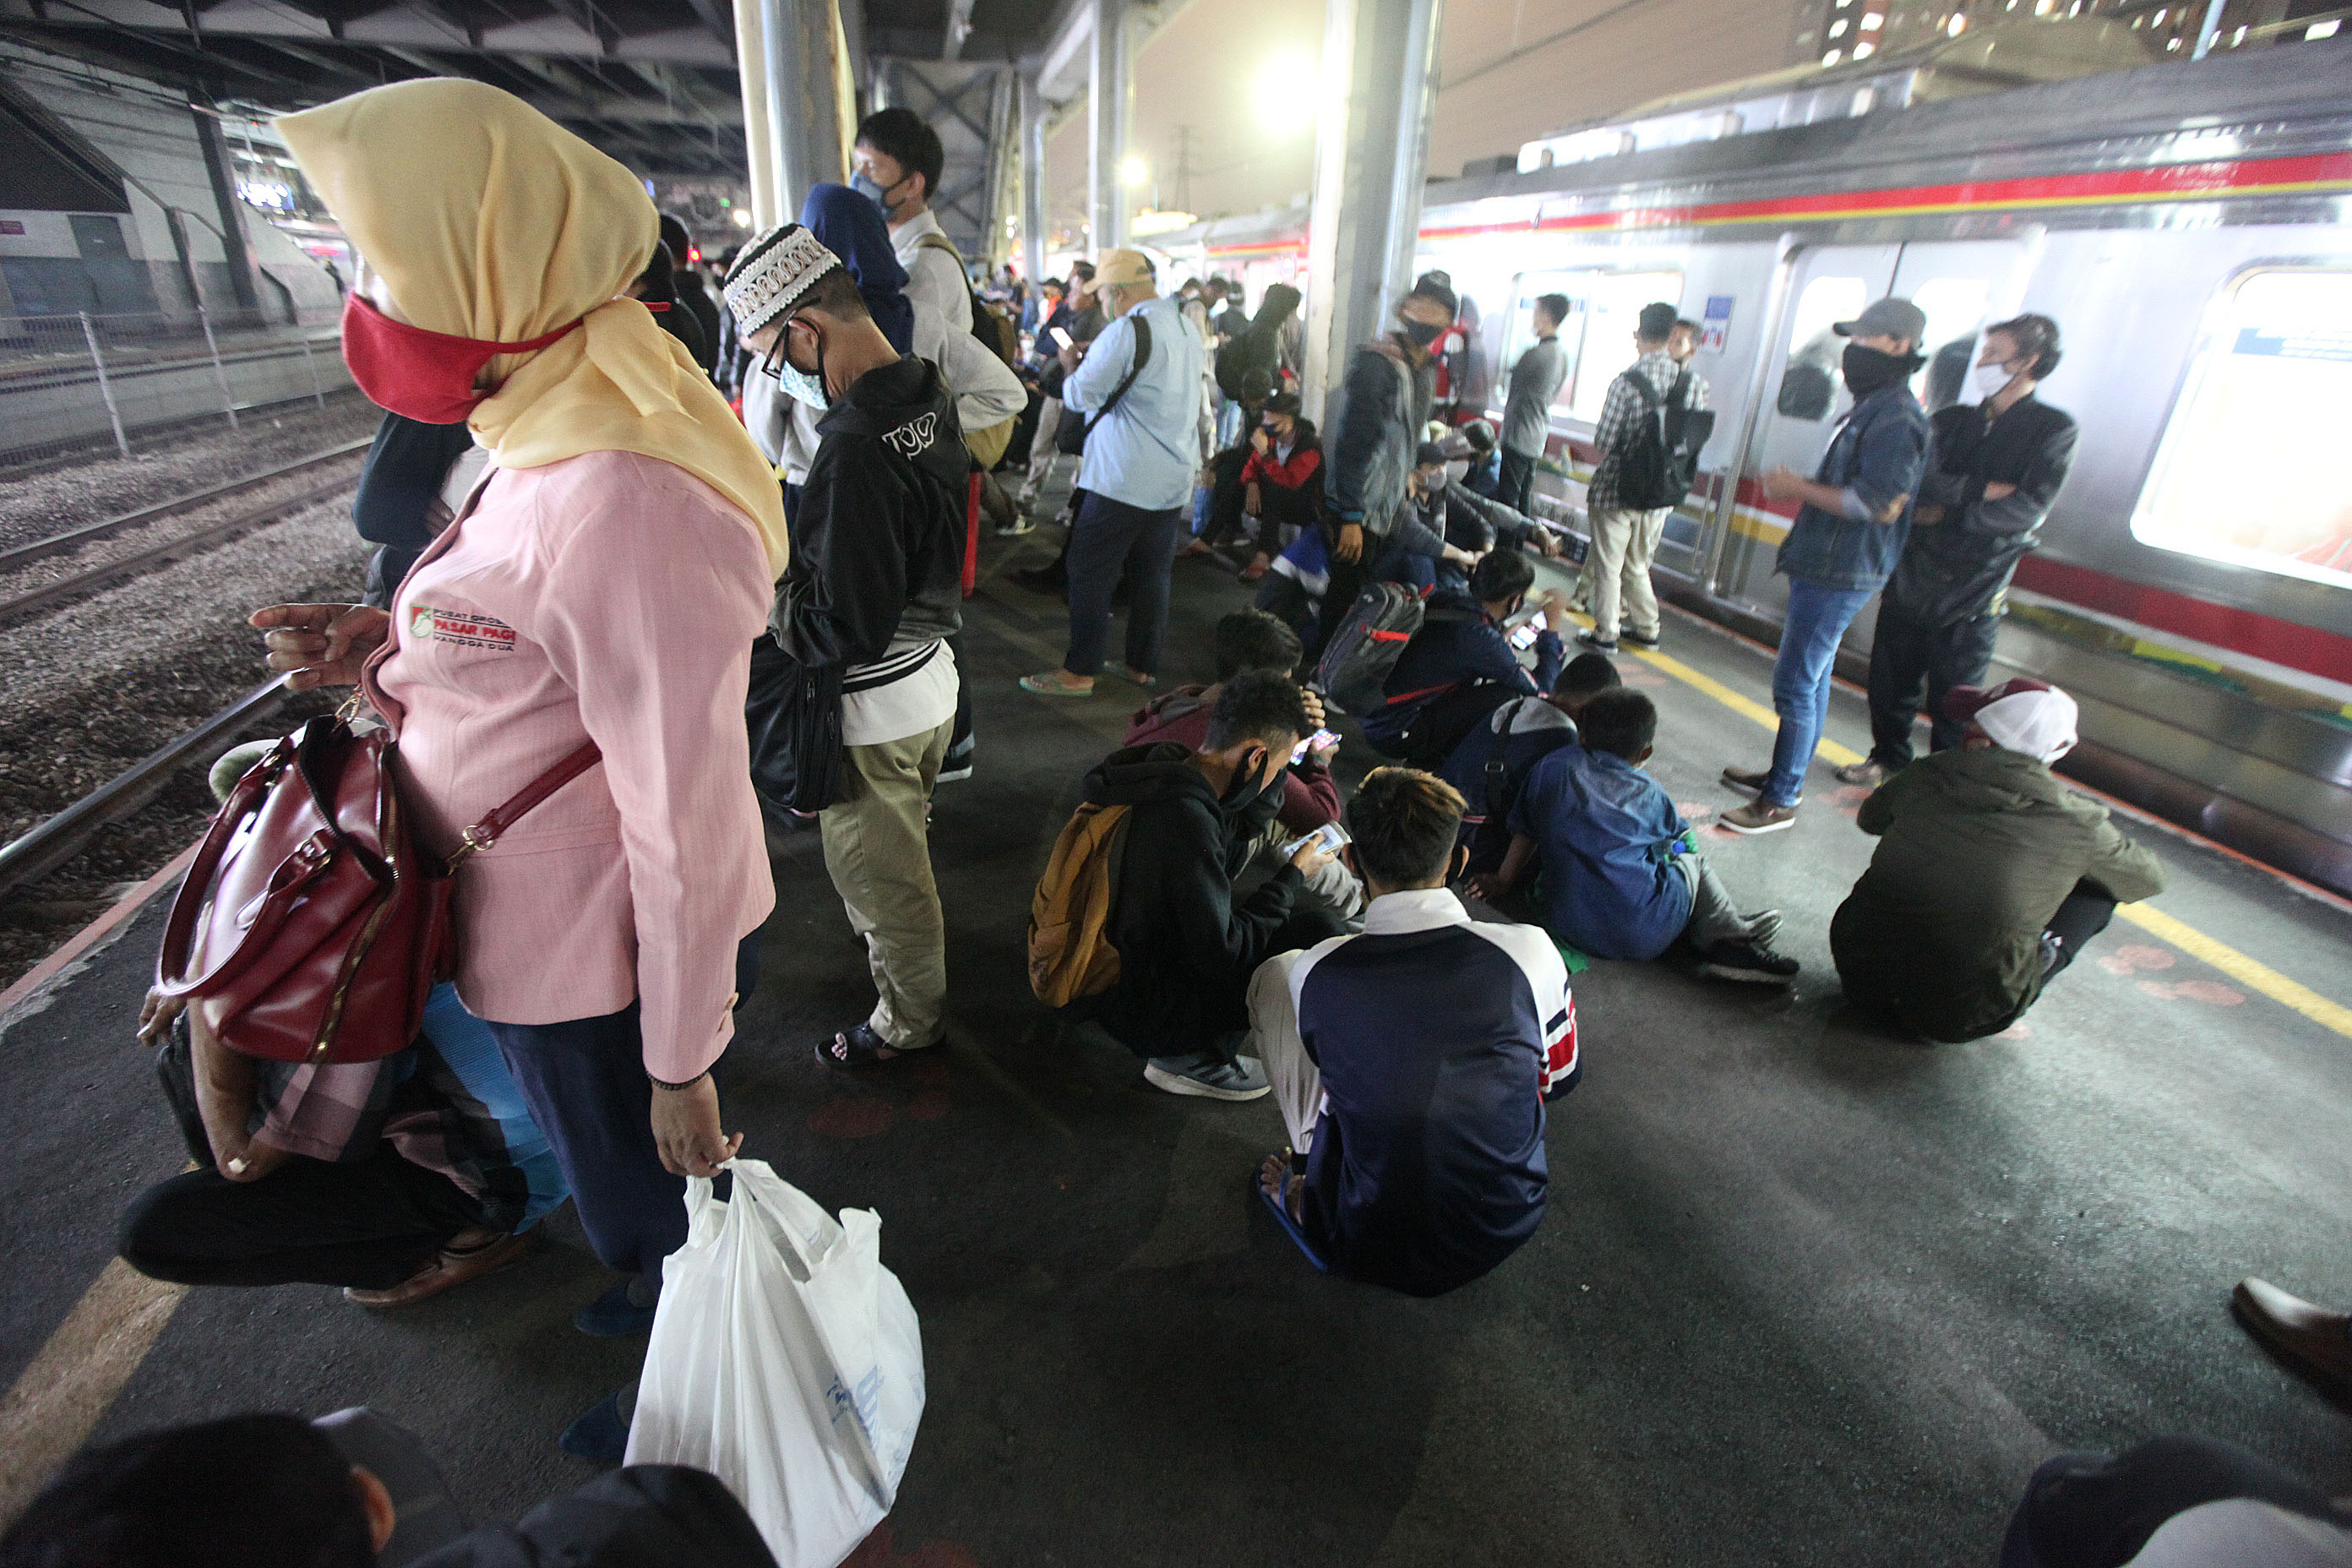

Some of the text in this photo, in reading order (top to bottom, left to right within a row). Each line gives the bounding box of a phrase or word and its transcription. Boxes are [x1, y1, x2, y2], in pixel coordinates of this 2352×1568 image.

[471, 615, 505, 625] GROS
[434, 618, 516, 642] PASAR PAGI
[487, 643, 514, 652] DUA
